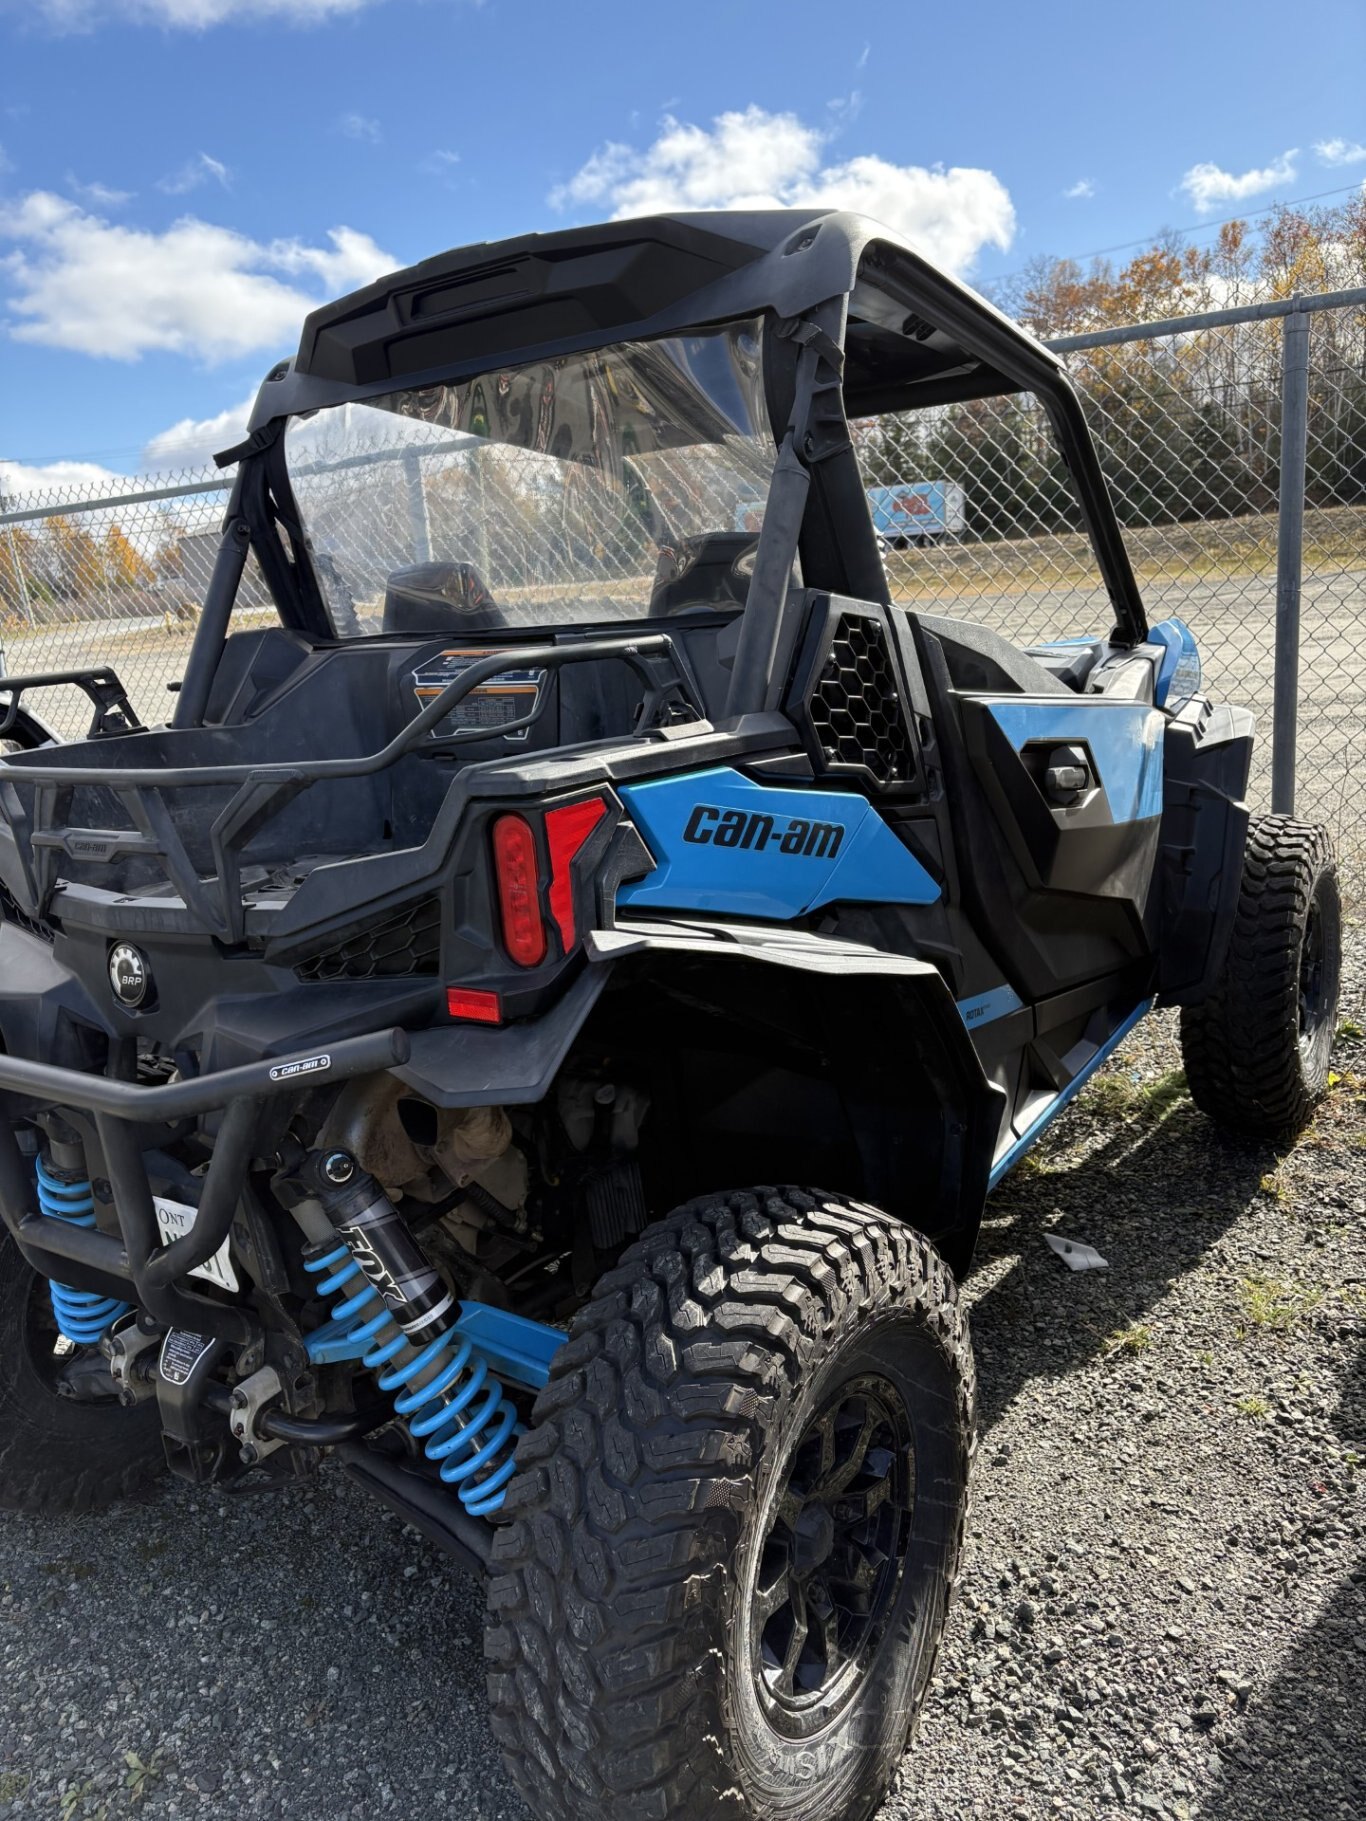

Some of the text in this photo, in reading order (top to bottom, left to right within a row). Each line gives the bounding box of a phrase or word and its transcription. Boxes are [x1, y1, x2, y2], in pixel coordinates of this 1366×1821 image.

[683, 806, 845, 859] can-am
[122, 975, 142, 986] BRP
[965, 1007, 985, 1020] ROTAX
[281, 1060, 318, 1076] can-am
[336, 1225, 408, 1303] FOX
